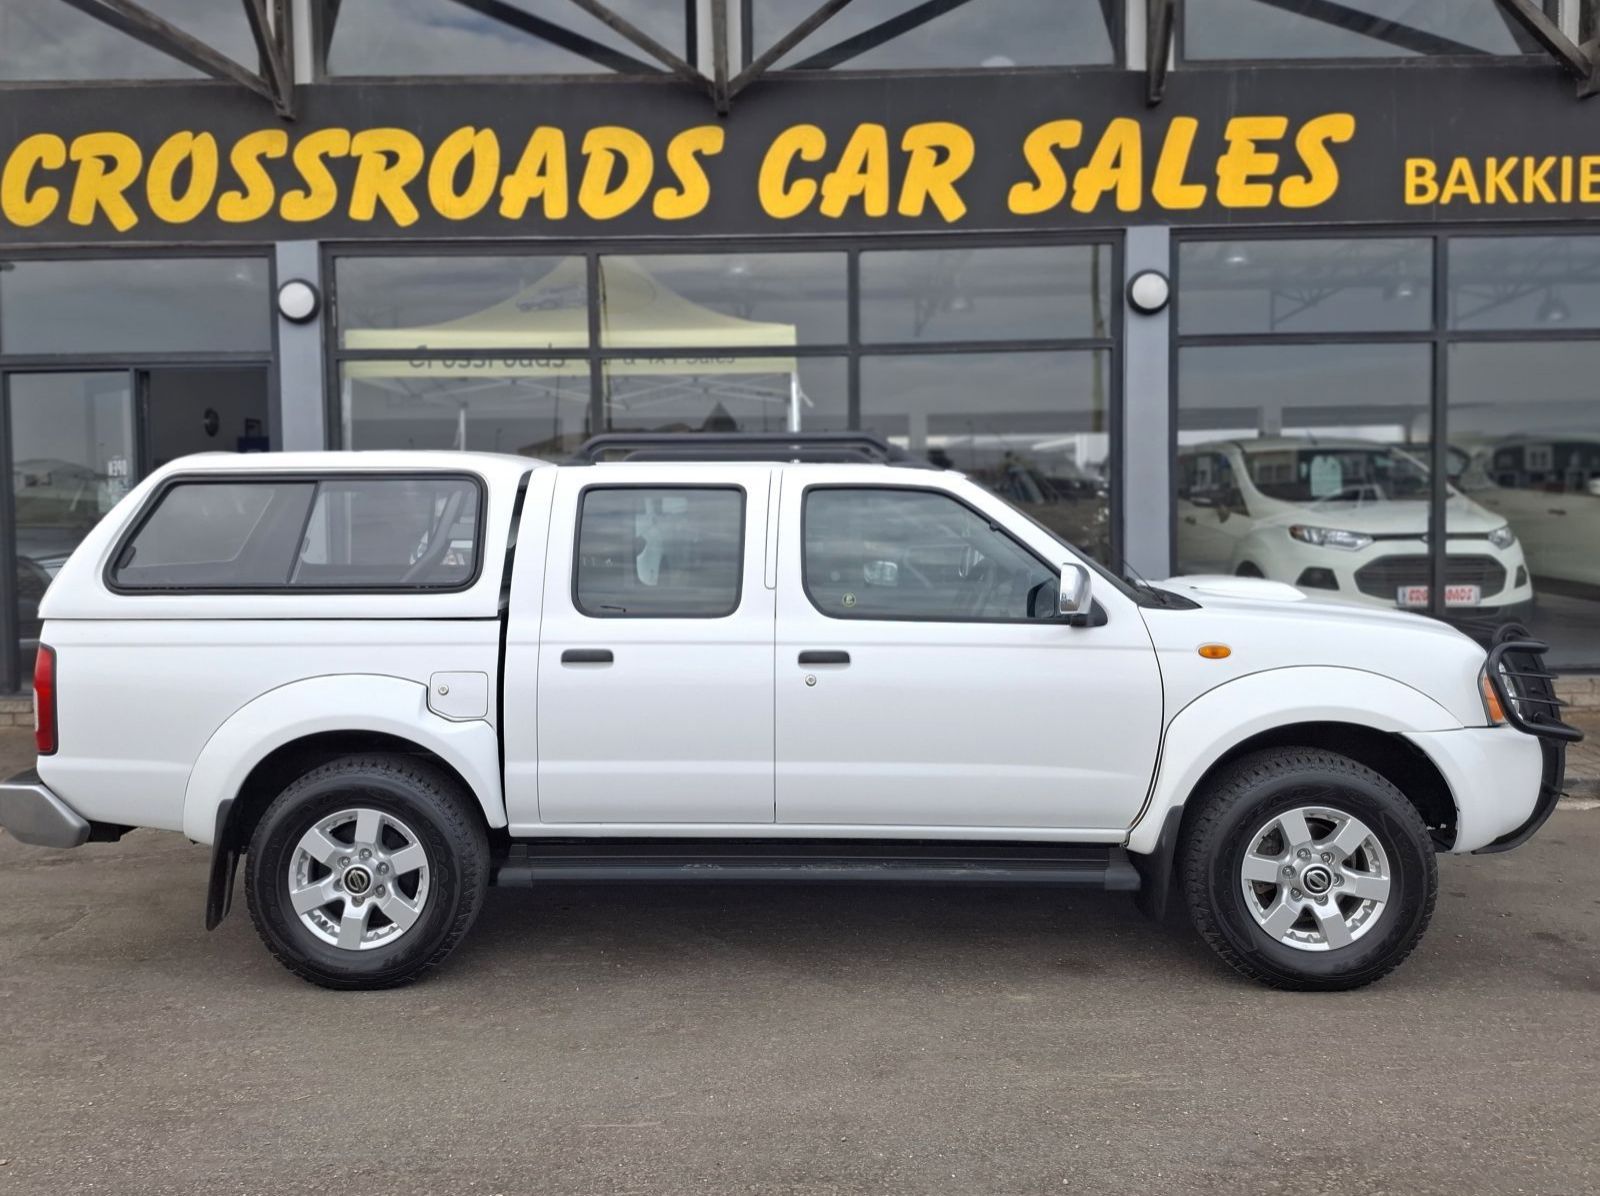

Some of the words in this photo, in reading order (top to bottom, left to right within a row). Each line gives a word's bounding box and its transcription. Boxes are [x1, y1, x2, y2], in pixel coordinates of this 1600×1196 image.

[0, 126, 724, 231] CROSSROADS
[758, 122, 975, 222] CAR
[1008, 113, 1355, 214] SALES
[1404, 155, 1600, 205] BAKKIE
